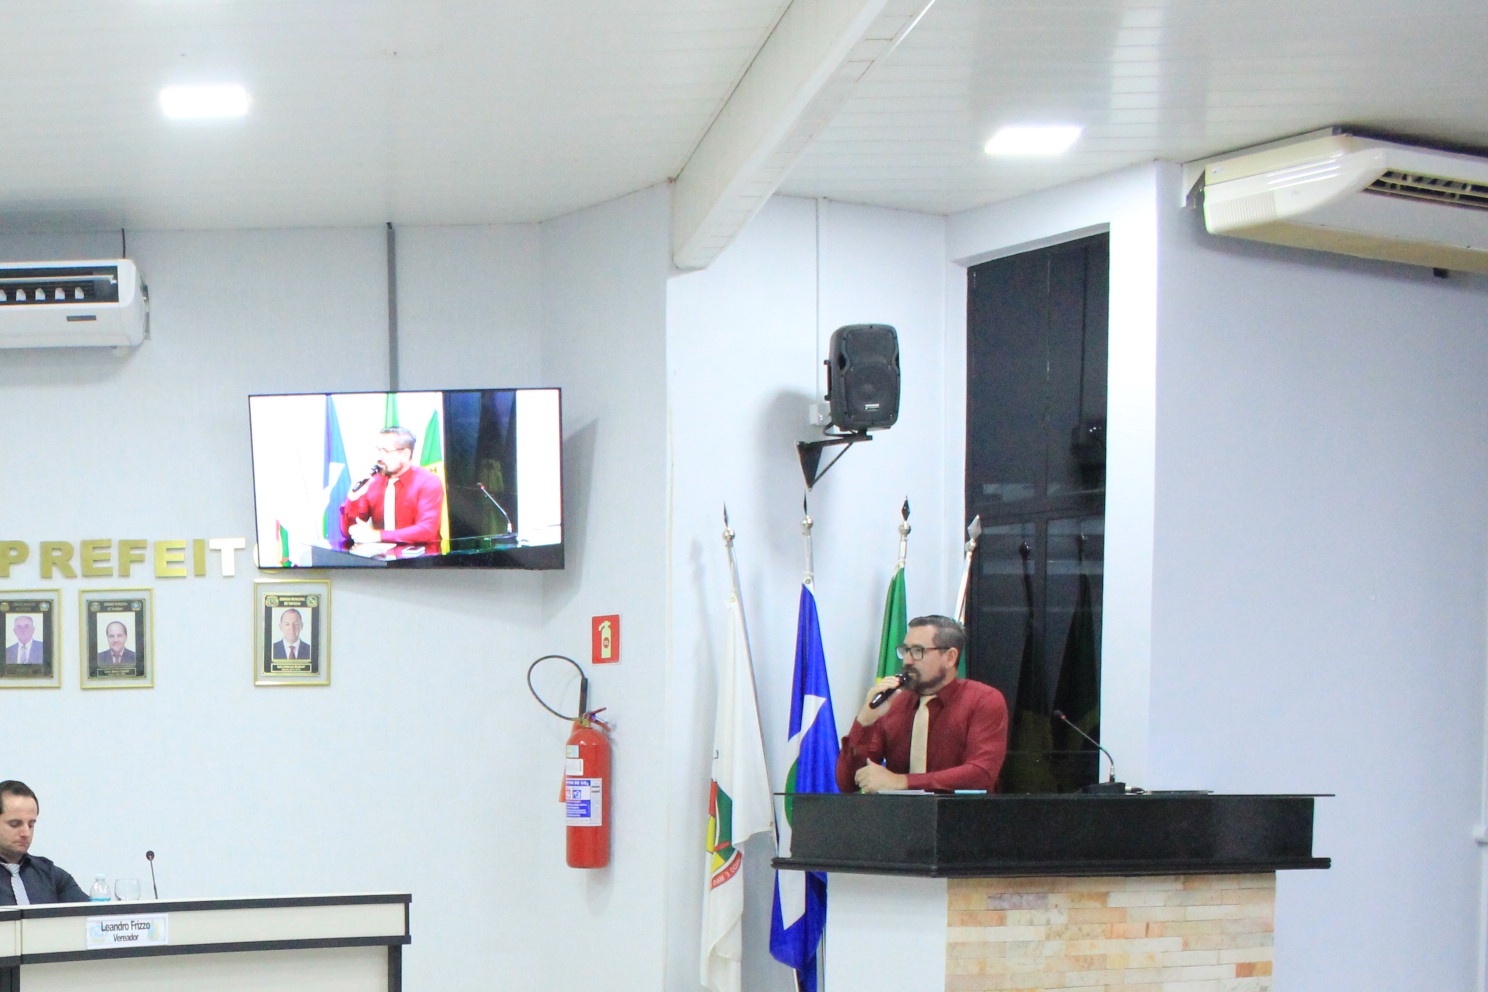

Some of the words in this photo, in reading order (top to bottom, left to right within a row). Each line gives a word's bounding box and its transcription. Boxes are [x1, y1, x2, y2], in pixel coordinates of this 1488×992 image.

[100, 921, 129, 932] Leandro
[131, 920, 150, 930] Frizzo
[113, 933, 139, 942] Vereador
